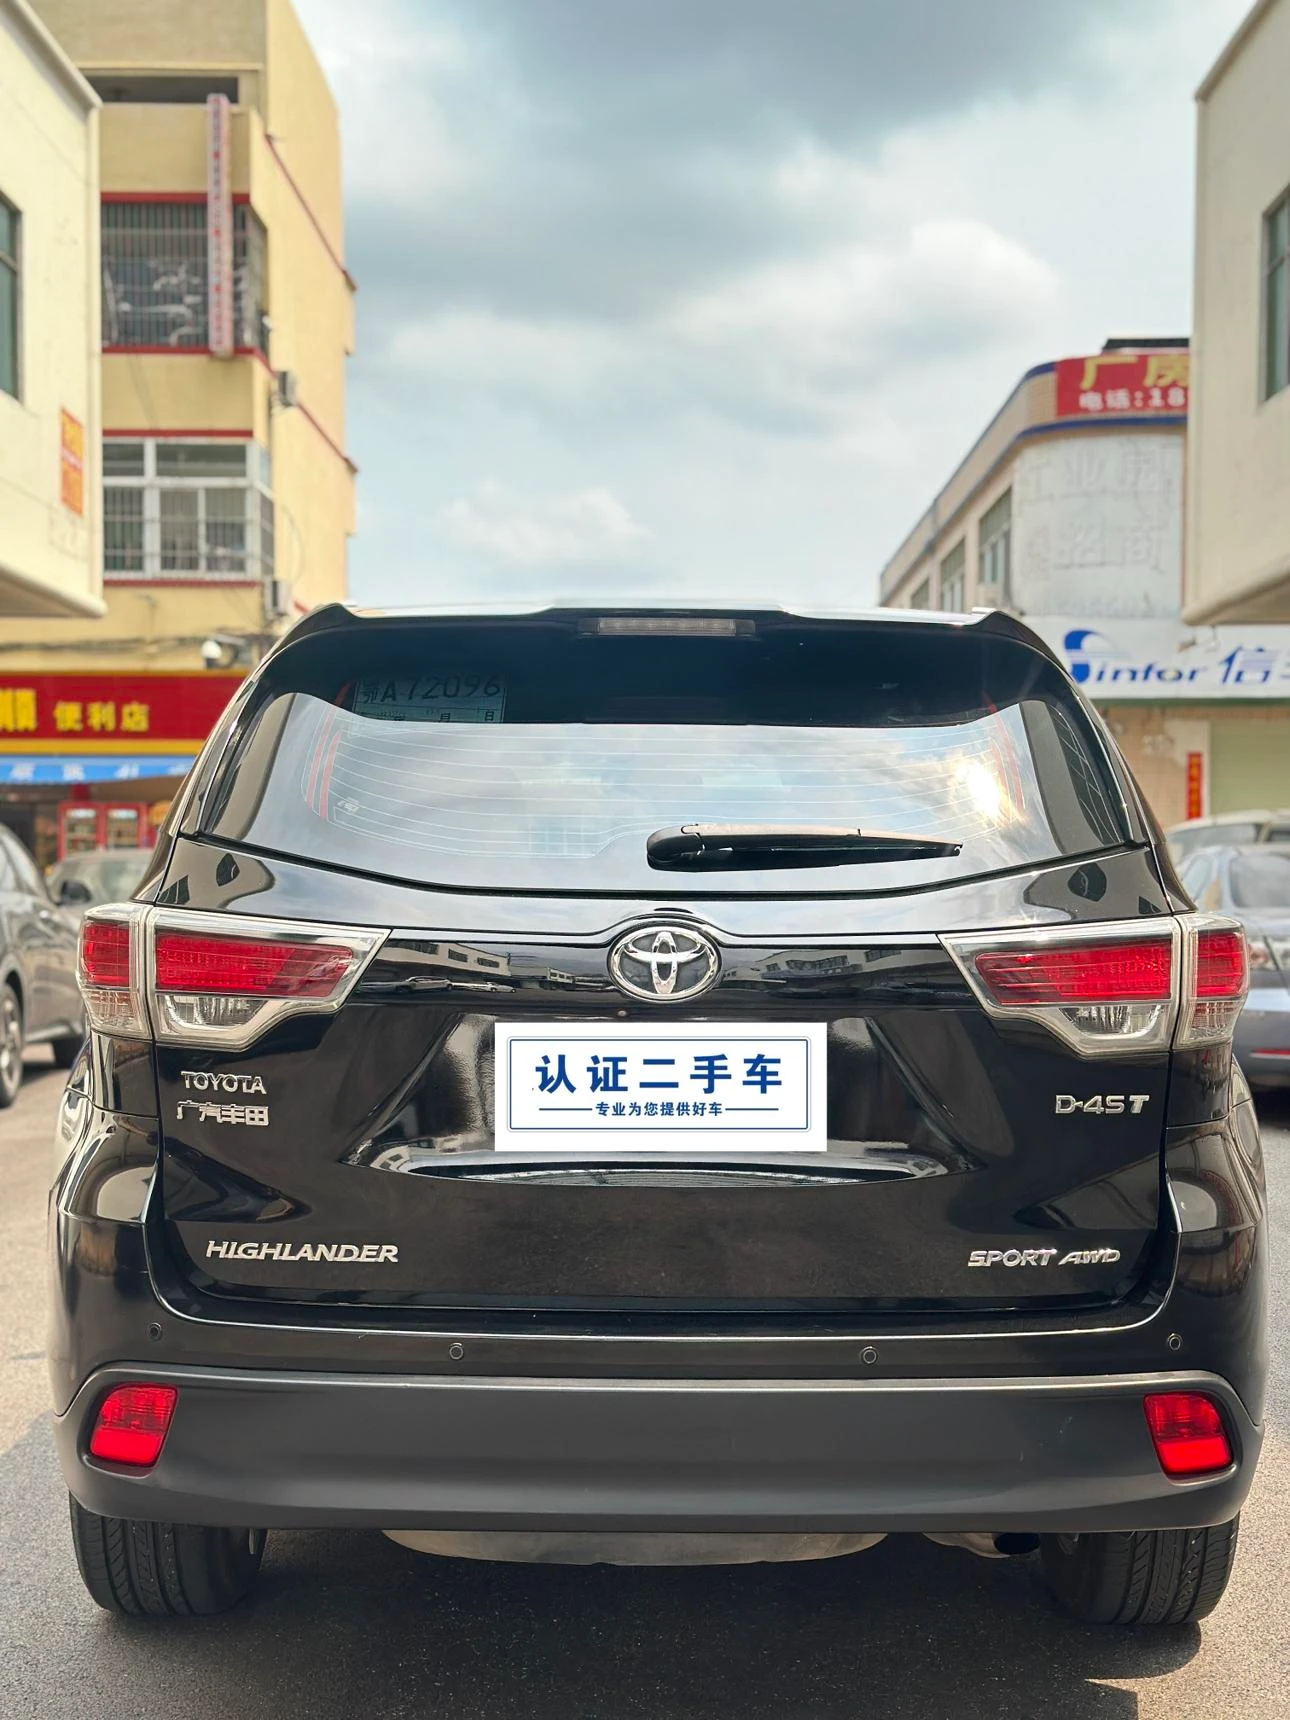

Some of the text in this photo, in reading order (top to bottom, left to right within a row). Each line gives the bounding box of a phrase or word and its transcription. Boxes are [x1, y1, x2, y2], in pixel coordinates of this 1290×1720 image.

[1078, 386, 1188, 411] 电话:18
[1219, 644, 1290, 684] 信
[53, 701, 149, 732] 便利店
[181, 1070, 267, 1095] TOYOTA
[176, 1100, 269, 1126] 广汽丰田
[206, 1240, 399, 1263] HIGHLANDER
[967, 1248, 1121, 1267] SPORT AWD
